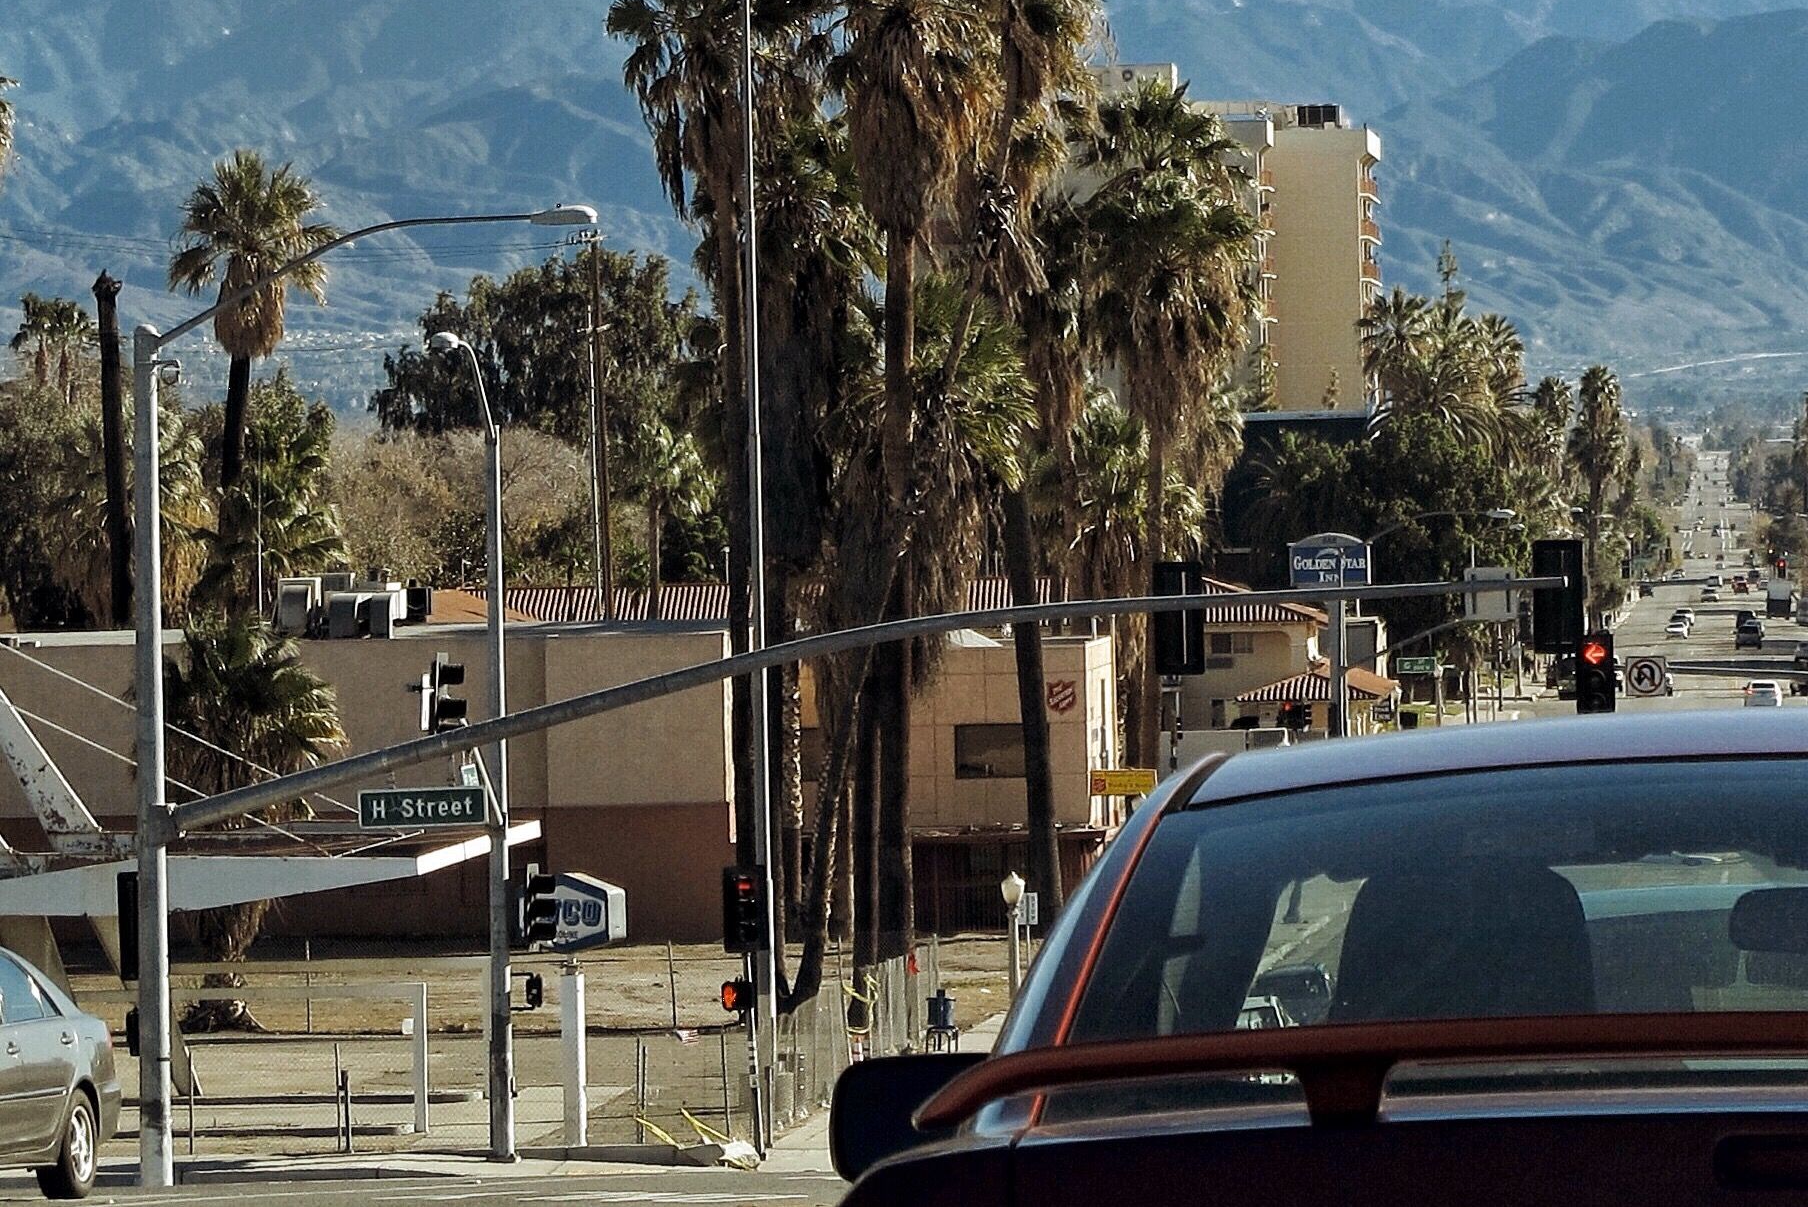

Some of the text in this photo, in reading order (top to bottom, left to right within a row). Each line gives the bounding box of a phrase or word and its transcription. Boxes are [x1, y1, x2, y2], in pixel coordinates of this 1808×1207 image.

[1293, 556, 1336, 570] GOLDEN
[372, 797, 473, 819] H Street
